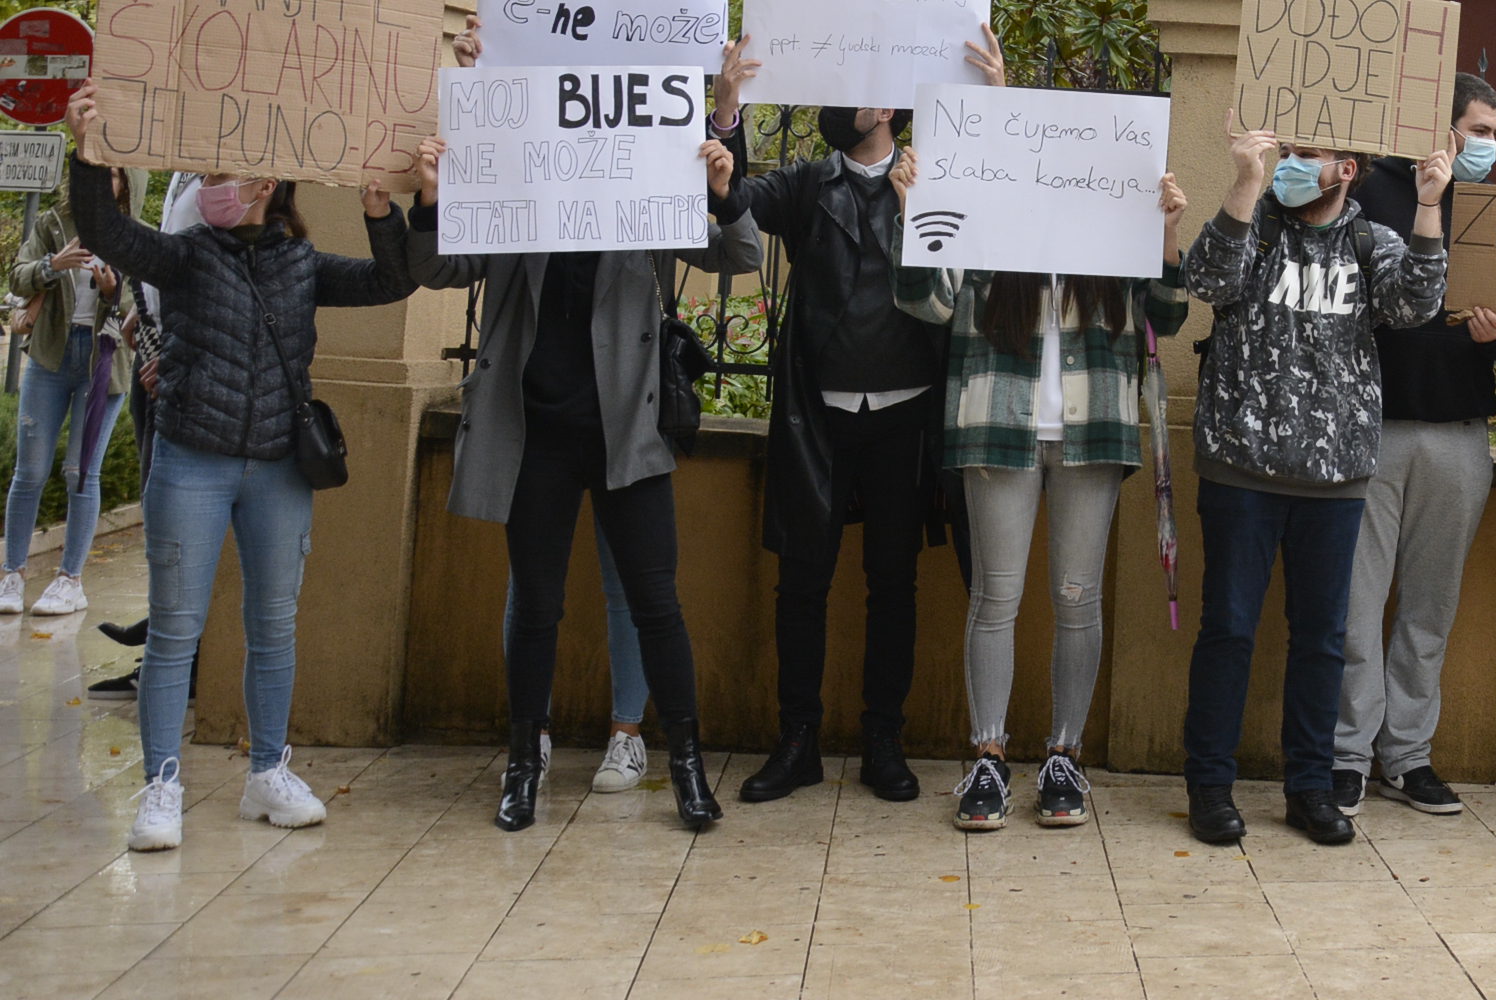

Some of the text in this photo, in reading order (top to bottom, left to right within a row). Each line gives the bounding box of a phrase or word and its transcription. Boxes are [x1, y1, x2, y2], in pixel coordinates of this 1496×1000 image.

[612, 1, 727, 46] može!
[836, 34, 882, 66] ljudski
[890, 39, 950, 61] mozak
[449, 72, 695, 131] MOJ BIJES
[932, 98, 982, 139] Ne
[1004, 111, 1098, 153] čujemo
[446, 130, 636, 185] NE MOŽE
[441, 193, 708, 244] STATI NA NATPIS
[1268, 261, 1359, 315] NIKE
